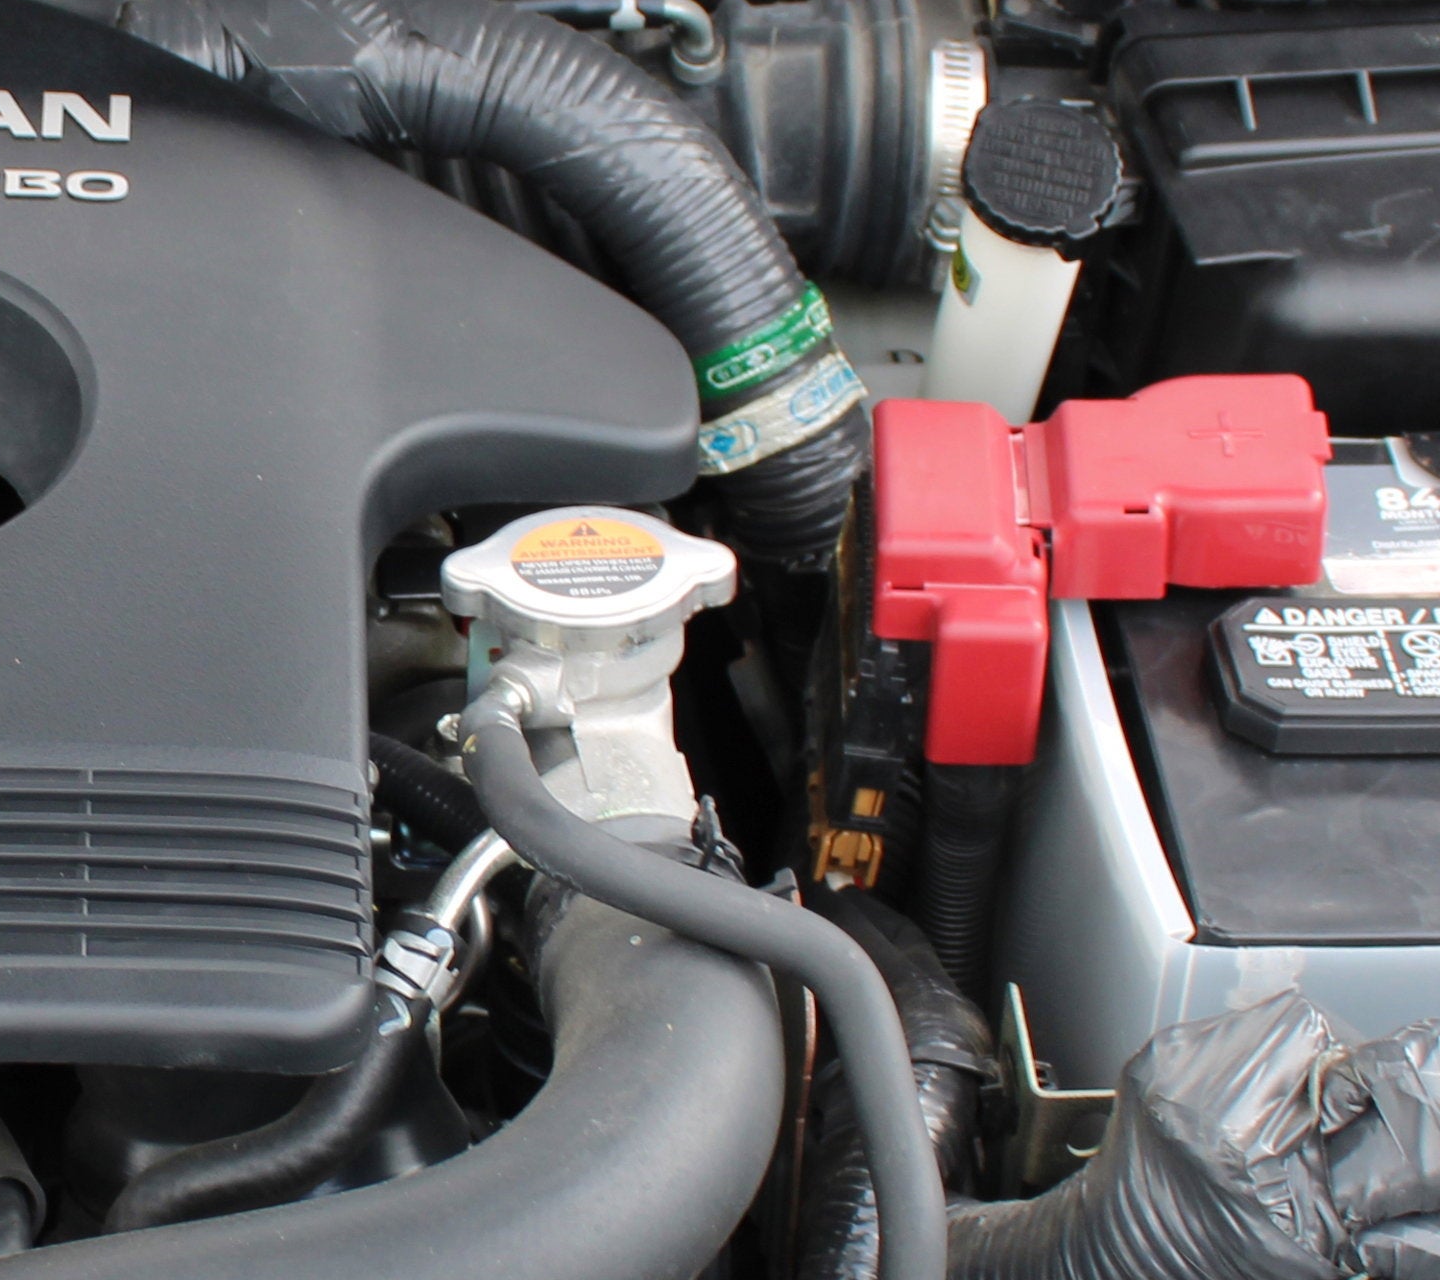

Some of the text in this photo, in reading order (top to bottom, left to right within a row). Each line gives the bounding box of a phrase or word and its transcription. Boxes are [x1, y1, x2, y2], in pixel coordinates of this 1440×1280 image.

[539, 536, 632, 548] WARNING
[518, 545, 656, 559] AVERTISSEMENT
[1282, 607, 1406, 625] DANGER
[1410, 607, 1427, 624] /
[1327, 635, 1382, 648] SHIELD
[1330, 646, 1369, 658] EYES
[1298, 657, 1379, 669] EXPLOSIVE
[1302, 667, 1352, 679] GASES
